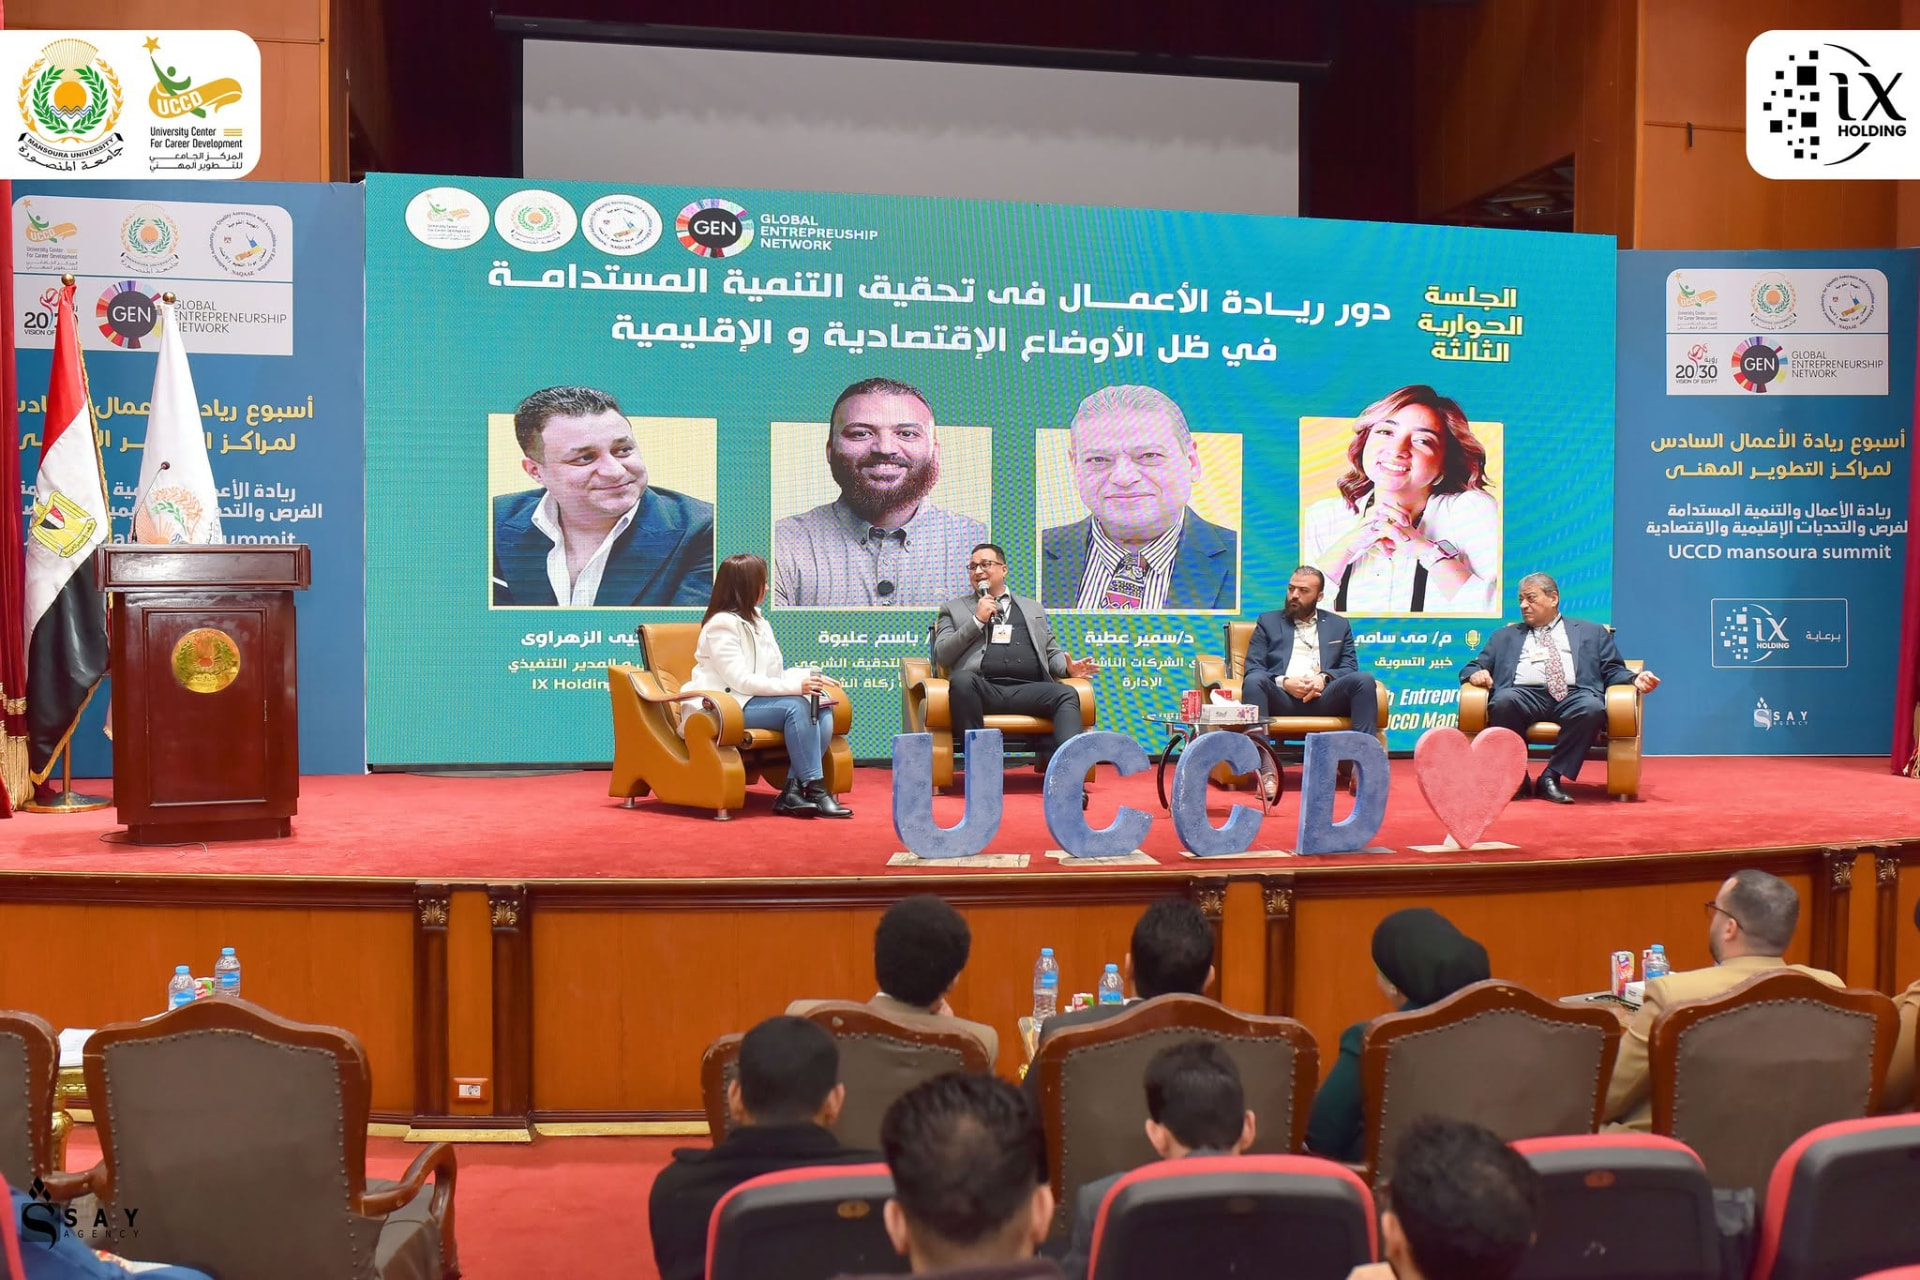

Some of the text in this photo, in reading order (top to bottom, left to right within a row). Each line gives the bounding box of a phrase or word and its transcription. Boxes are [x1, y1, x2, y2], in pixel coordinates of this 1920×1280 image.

[693, 220, 737, 237] GEN
[760, 213, 819, 226] GLOBAL
[760, 225, 879, 241] ENTREPREUSHIP
[760, 238, 833, 251] NETWORK
[723, 268, 844, 303] التنمية
[858, 274, 976, 308] تحقيق
[1424, 285, 1517, 311] الجلسة
[112, 305, 152, 323] GEN
[1334, 301, 1391, 328] دور
[611, 313, 772, 353] الإقليمية
[1417, 312, 1523, 339] الحوارية
[787, 325, 810, 354] و
[823, 321, 1007, 360] الإقتصادية
[1021, 325, 1144, 364] الأوضاع
[1157, 333, 1209, 364] ظل
[1431, 338, 1510, 362] الثالثة
[1792, 351, 1827, 360] GLOBAL
[1743, 357, 1776, 371] GEN
[1792, 360, 1884, 369] ENTREPRENEURSHIP
[1792, 369, 1838, 378] NETWORK
[200, 398, 238, 422] رياد
[246, 395, 315, 427] أسبوع
[220, 430, 296, 455] لمراكز
[1650, 428, 1906, 455] أسبوع ريادة الأعمال السادس
[1749, 461, 1824, 480] التطوير
[1829, 459, 1892, 480] لمراكز
[253, 482, 296, 502] ريادة
[269, 502, 323, 523] الفرص
[1667, 501, 1892, 519] ريادة الأعمال والتنمية المستدامة
[222, 531, 296, 545] ummit
[1646, 520, 1909, 539] لفرص والتحديات الإقليمية والاقتصادية
[1668, 544, 1892, 559] UCCD mansoura summit
[818, 630, 868, 648] عليوة
[874, 630, 919, 648] باسم
[1084, 630, 1130, 647] عطية
[1805, 630, 1841, 643] برعاية
[852, 656, 900, 671] لتدقيق
[1131, 656, 1184, 670] الشركات
[1374, 656, 1453, 669] خبير التسويق
[532, 679, 549, 690] IX
[1122, 676, 1162, 690] الإدارة
[1773, 711, 1808, 721] SAY
